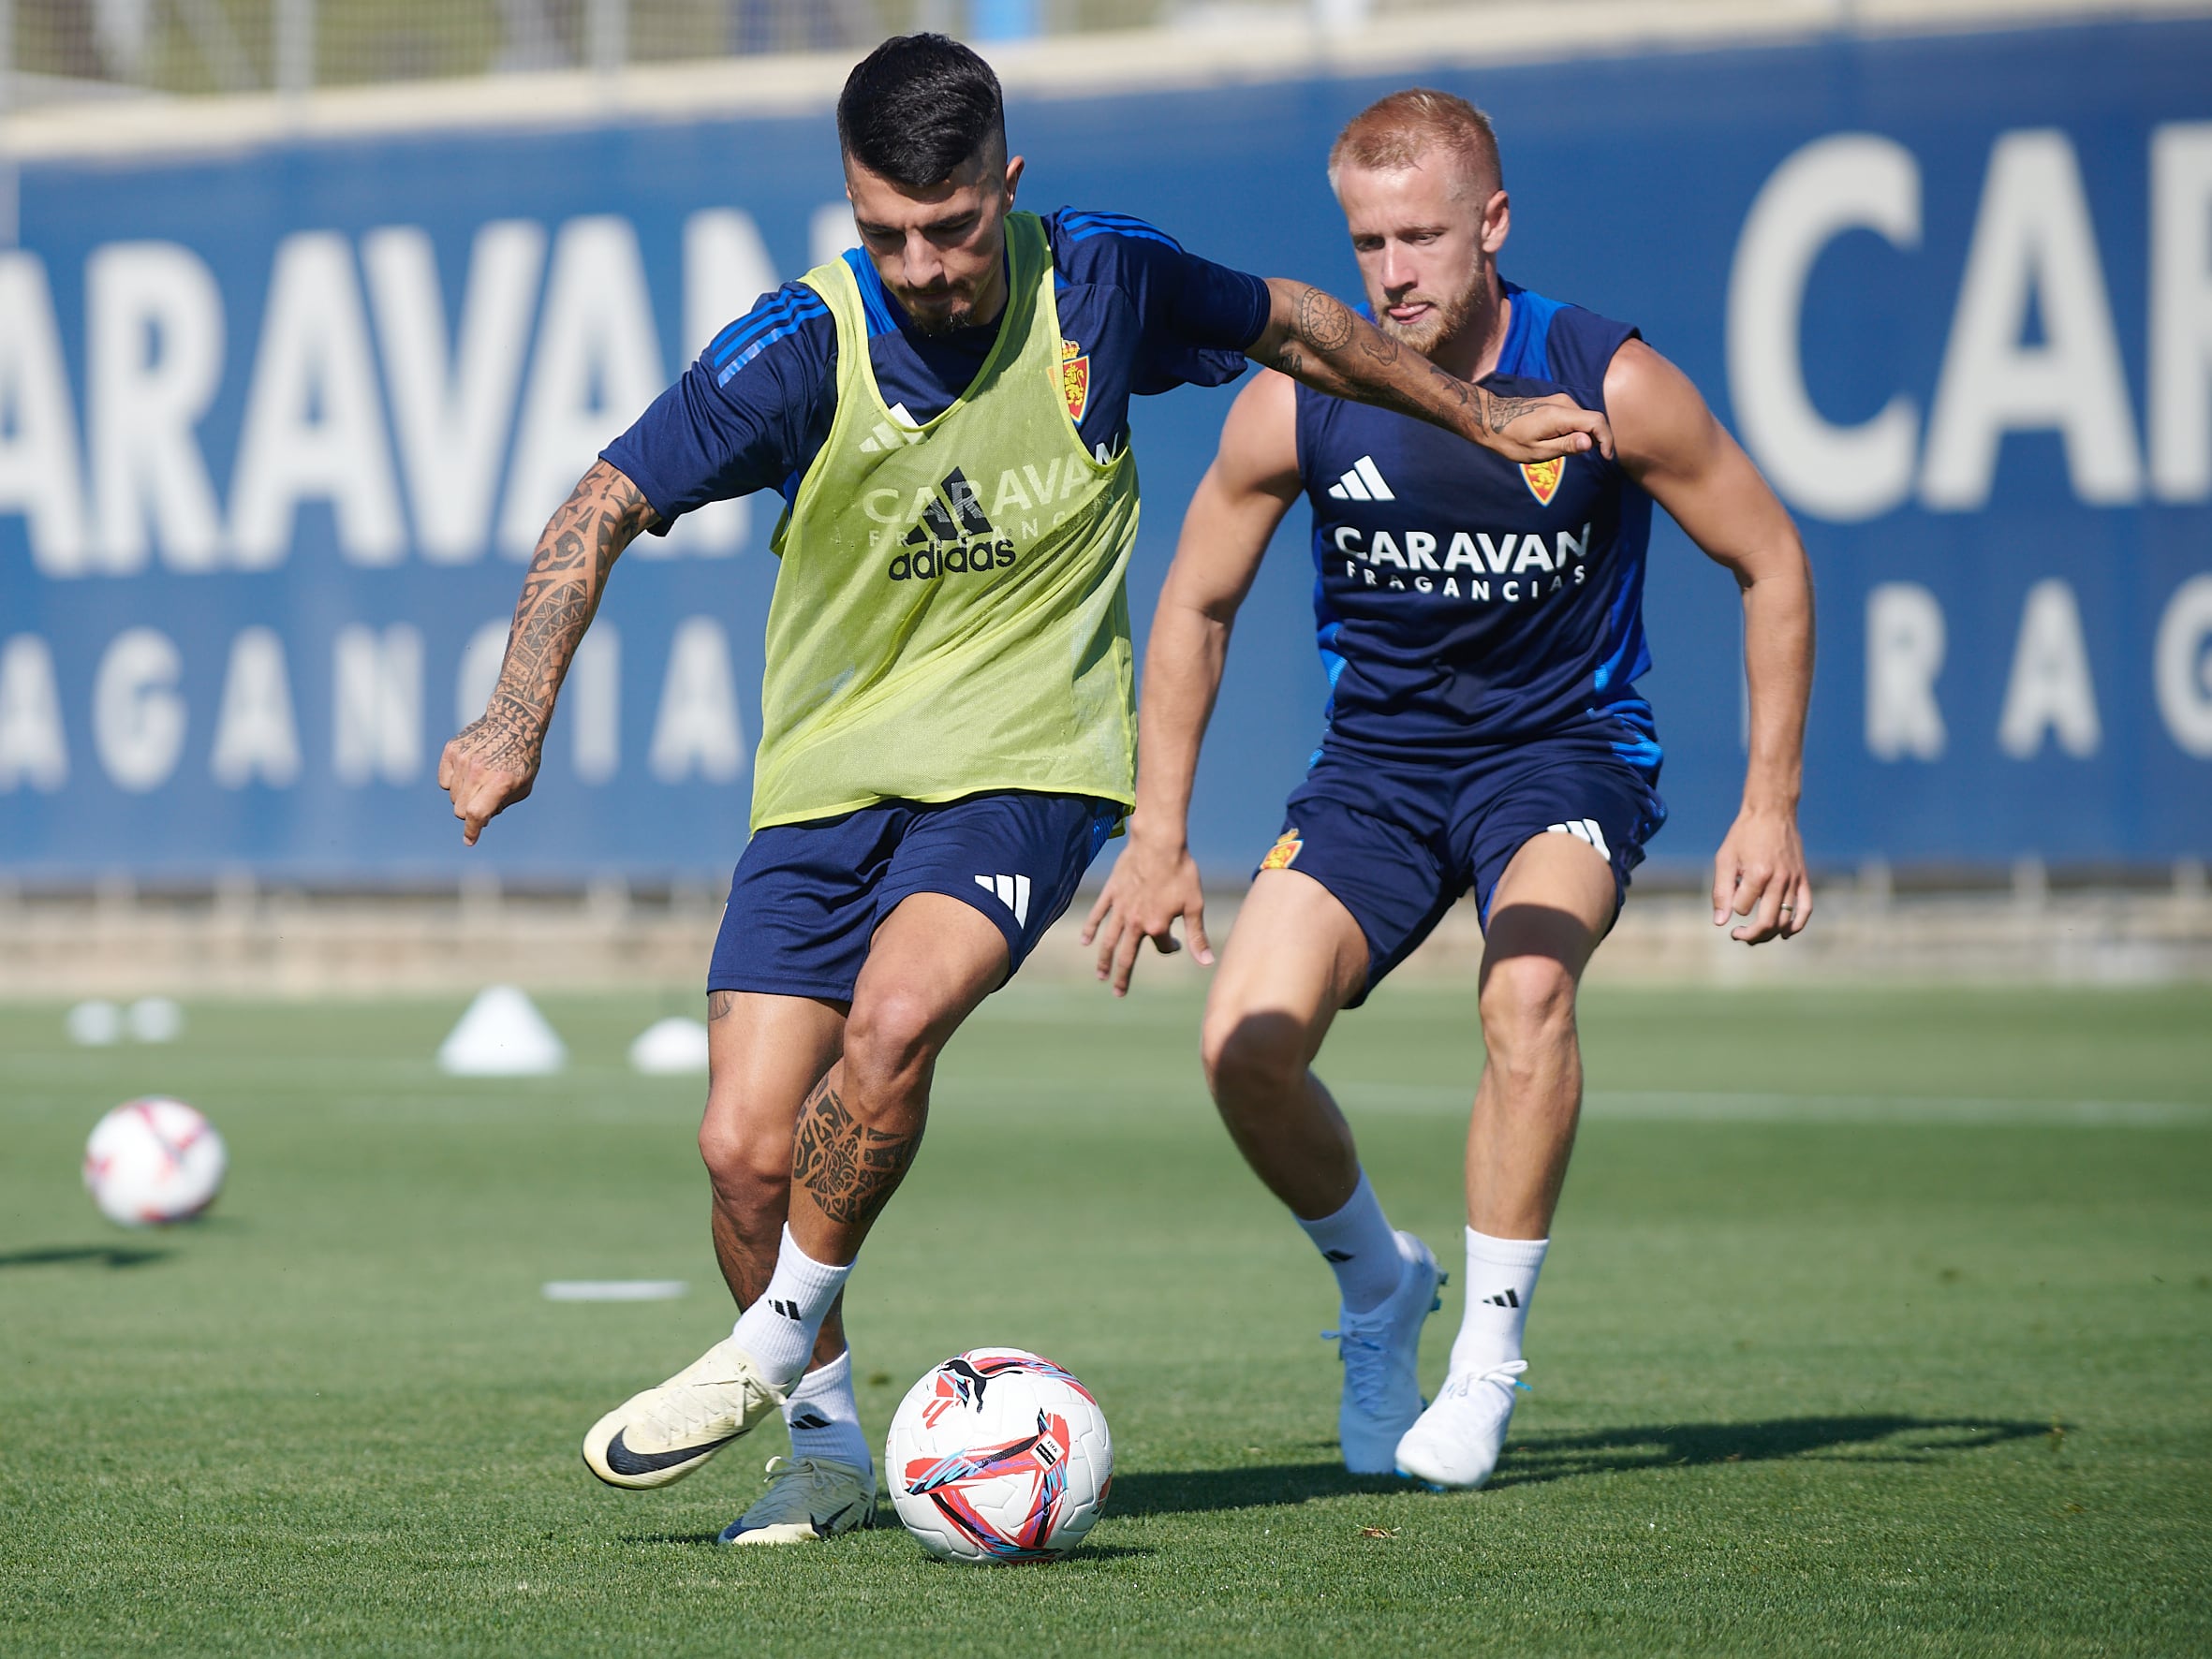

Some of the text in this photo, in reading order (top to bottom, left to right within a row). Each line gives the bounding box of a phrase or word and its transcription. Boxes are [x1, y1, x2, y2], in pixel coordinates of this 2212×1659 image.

[889, 539, 1016, 580] adidas
[1335, 521, 1591, 574] CARAVAN
[1347, 560, 1585, 601] FRAGANCIAS
[1744, 573, 2212, 763] RAG
